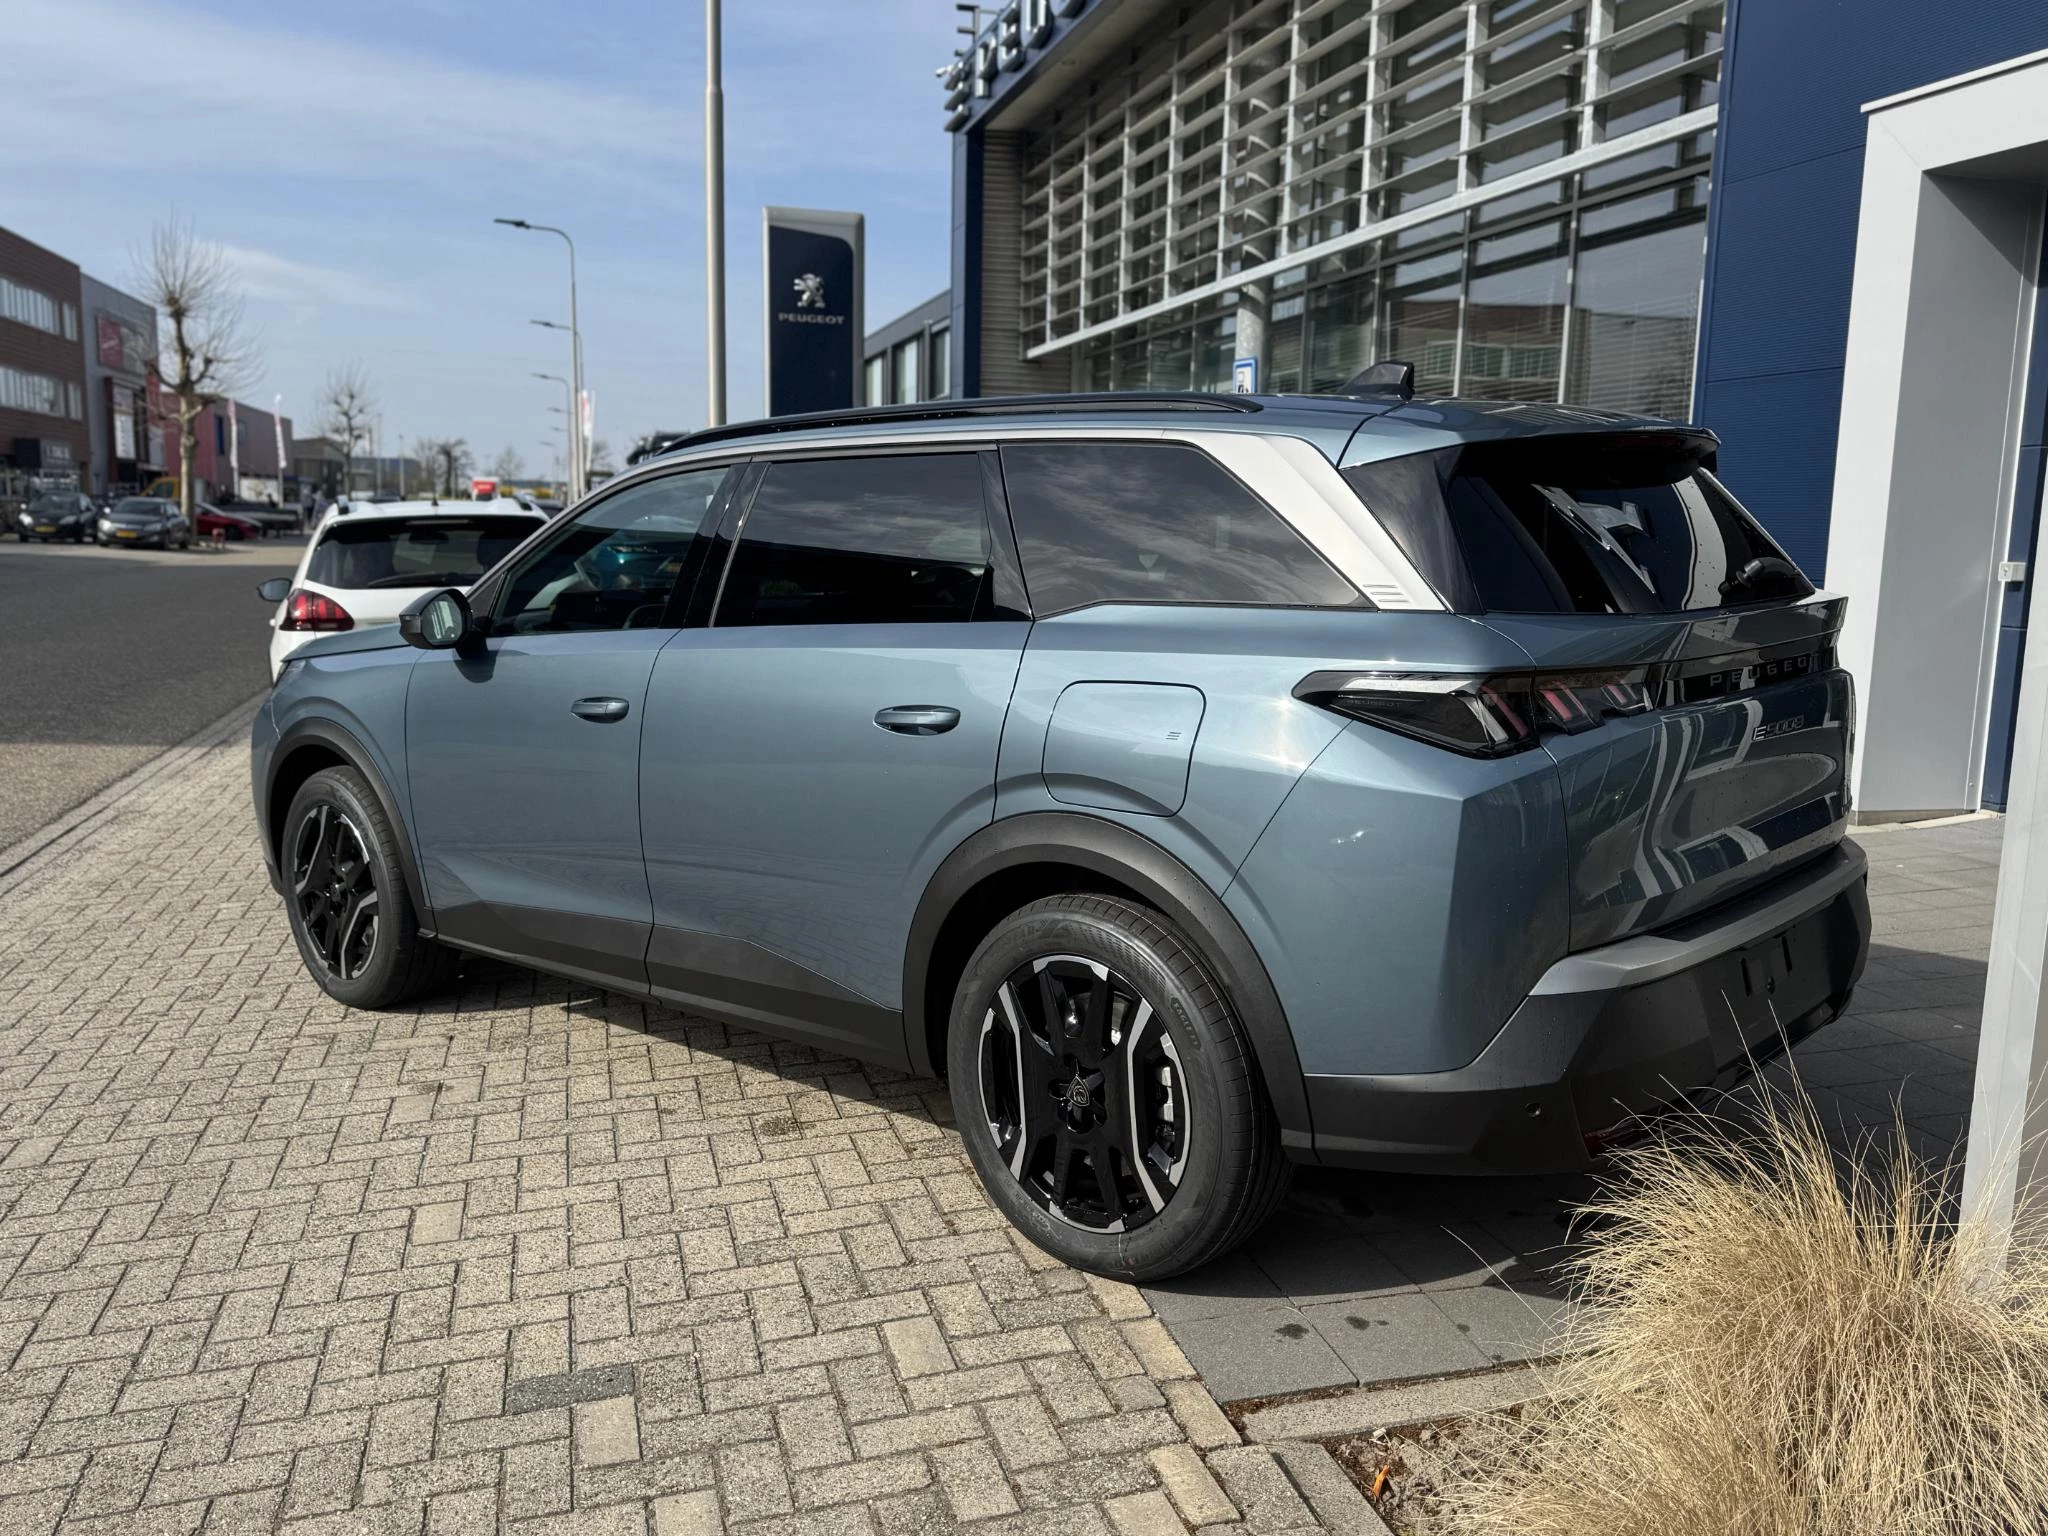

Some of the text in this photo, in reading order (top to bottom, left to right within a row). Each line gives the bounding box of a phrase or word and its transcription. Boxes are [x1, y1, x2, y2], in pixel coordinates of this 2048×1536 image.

[974, 0, 1086, 98] PEU
[778, 312, 844, 325] PEUGEOT
[1709, 655, 1810, 688] PEUGEO
